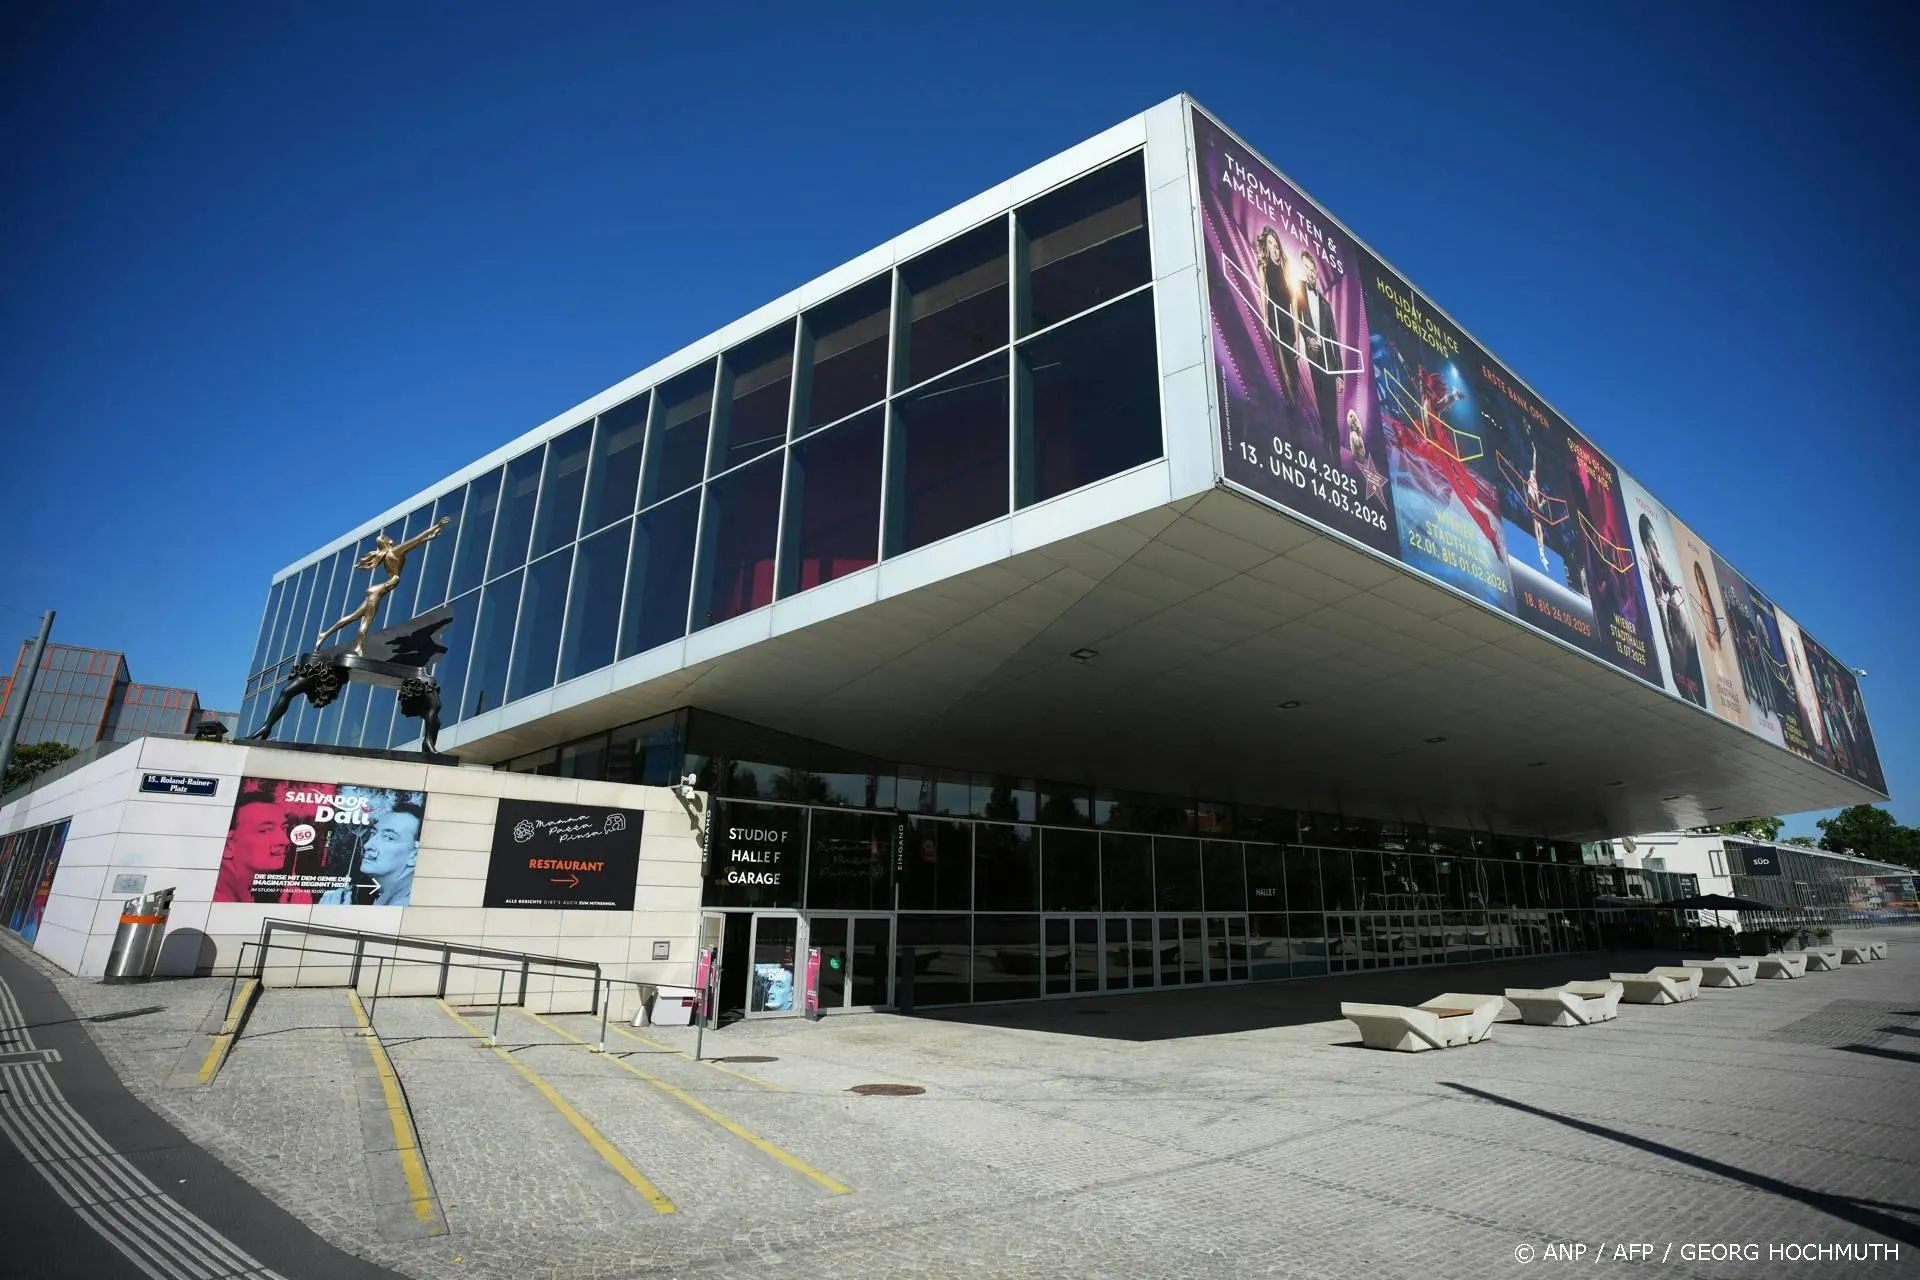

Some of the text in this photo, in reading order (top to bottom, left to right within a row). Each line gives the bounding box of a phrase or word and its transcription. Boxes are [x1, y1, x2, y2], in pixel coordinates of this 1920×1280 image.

[1224, 153, 1336, 254] THOMMY TEN &
[1281, 214, 1308, 247] VAN
[1313, 240, 1343, 274] TASS
[1376, 276, 1459, 355] HOLIDAY ON ICE
[1395, 306, 1449, 359] HORIZONS
[1273, 436, 1357, 495] 05.04.2025
[1240, 441, 1387, 531] 13. UND 14.03.2026
[1409, 528, 1507, 593] 22.01. BIS 01.02.2026
[1610, 623, 1646, 653] STADTHALLE
[160, 776, 213, 786] Roland-Rainer-
[285, 791, 369, 808] SALVADOR
[536, 815, 590, 828] Mamma
[294, 831, 312, 840] 150
[559, 831, 603, 843] Pinsa
[703, 809, 712, 862] EINGANG
[729, 827, 788, 842] STUDIO F
[529, 858, 605, 871] RESTAURANT
[731, 849, 781, 863] HALLE F
[1753, 857, 1770, 865] SÜD
[727, 871, 781, 885] GARAGE
